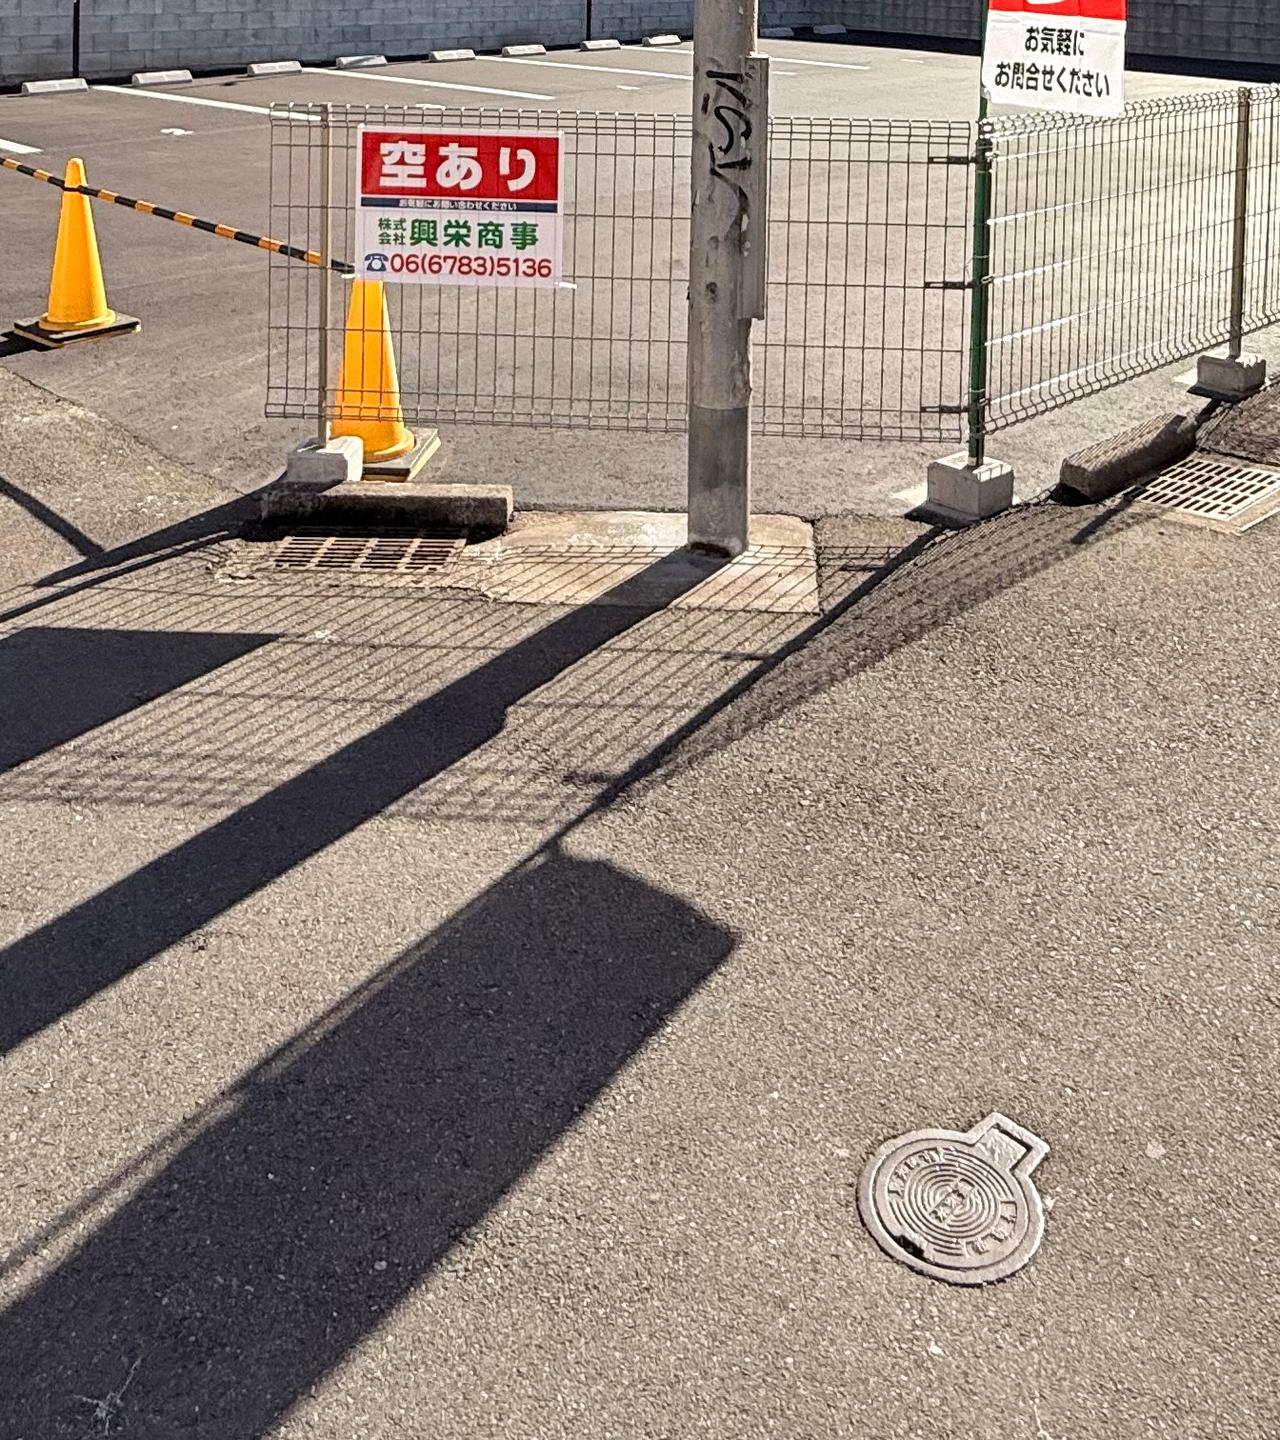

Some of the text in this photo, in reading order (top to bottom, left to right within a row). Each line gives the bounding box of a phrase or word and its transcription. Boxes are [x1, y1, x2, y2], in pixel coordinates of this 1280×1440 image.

[1024, 26, 1085, 56] お気軽に
[994, 61, 1110, 97] お問合せください
[379, 140, 536, 192] 空あり
[409, 218, 539, 250] 興栄商事
[390, 253, 552, 278] 06(6783)5136
